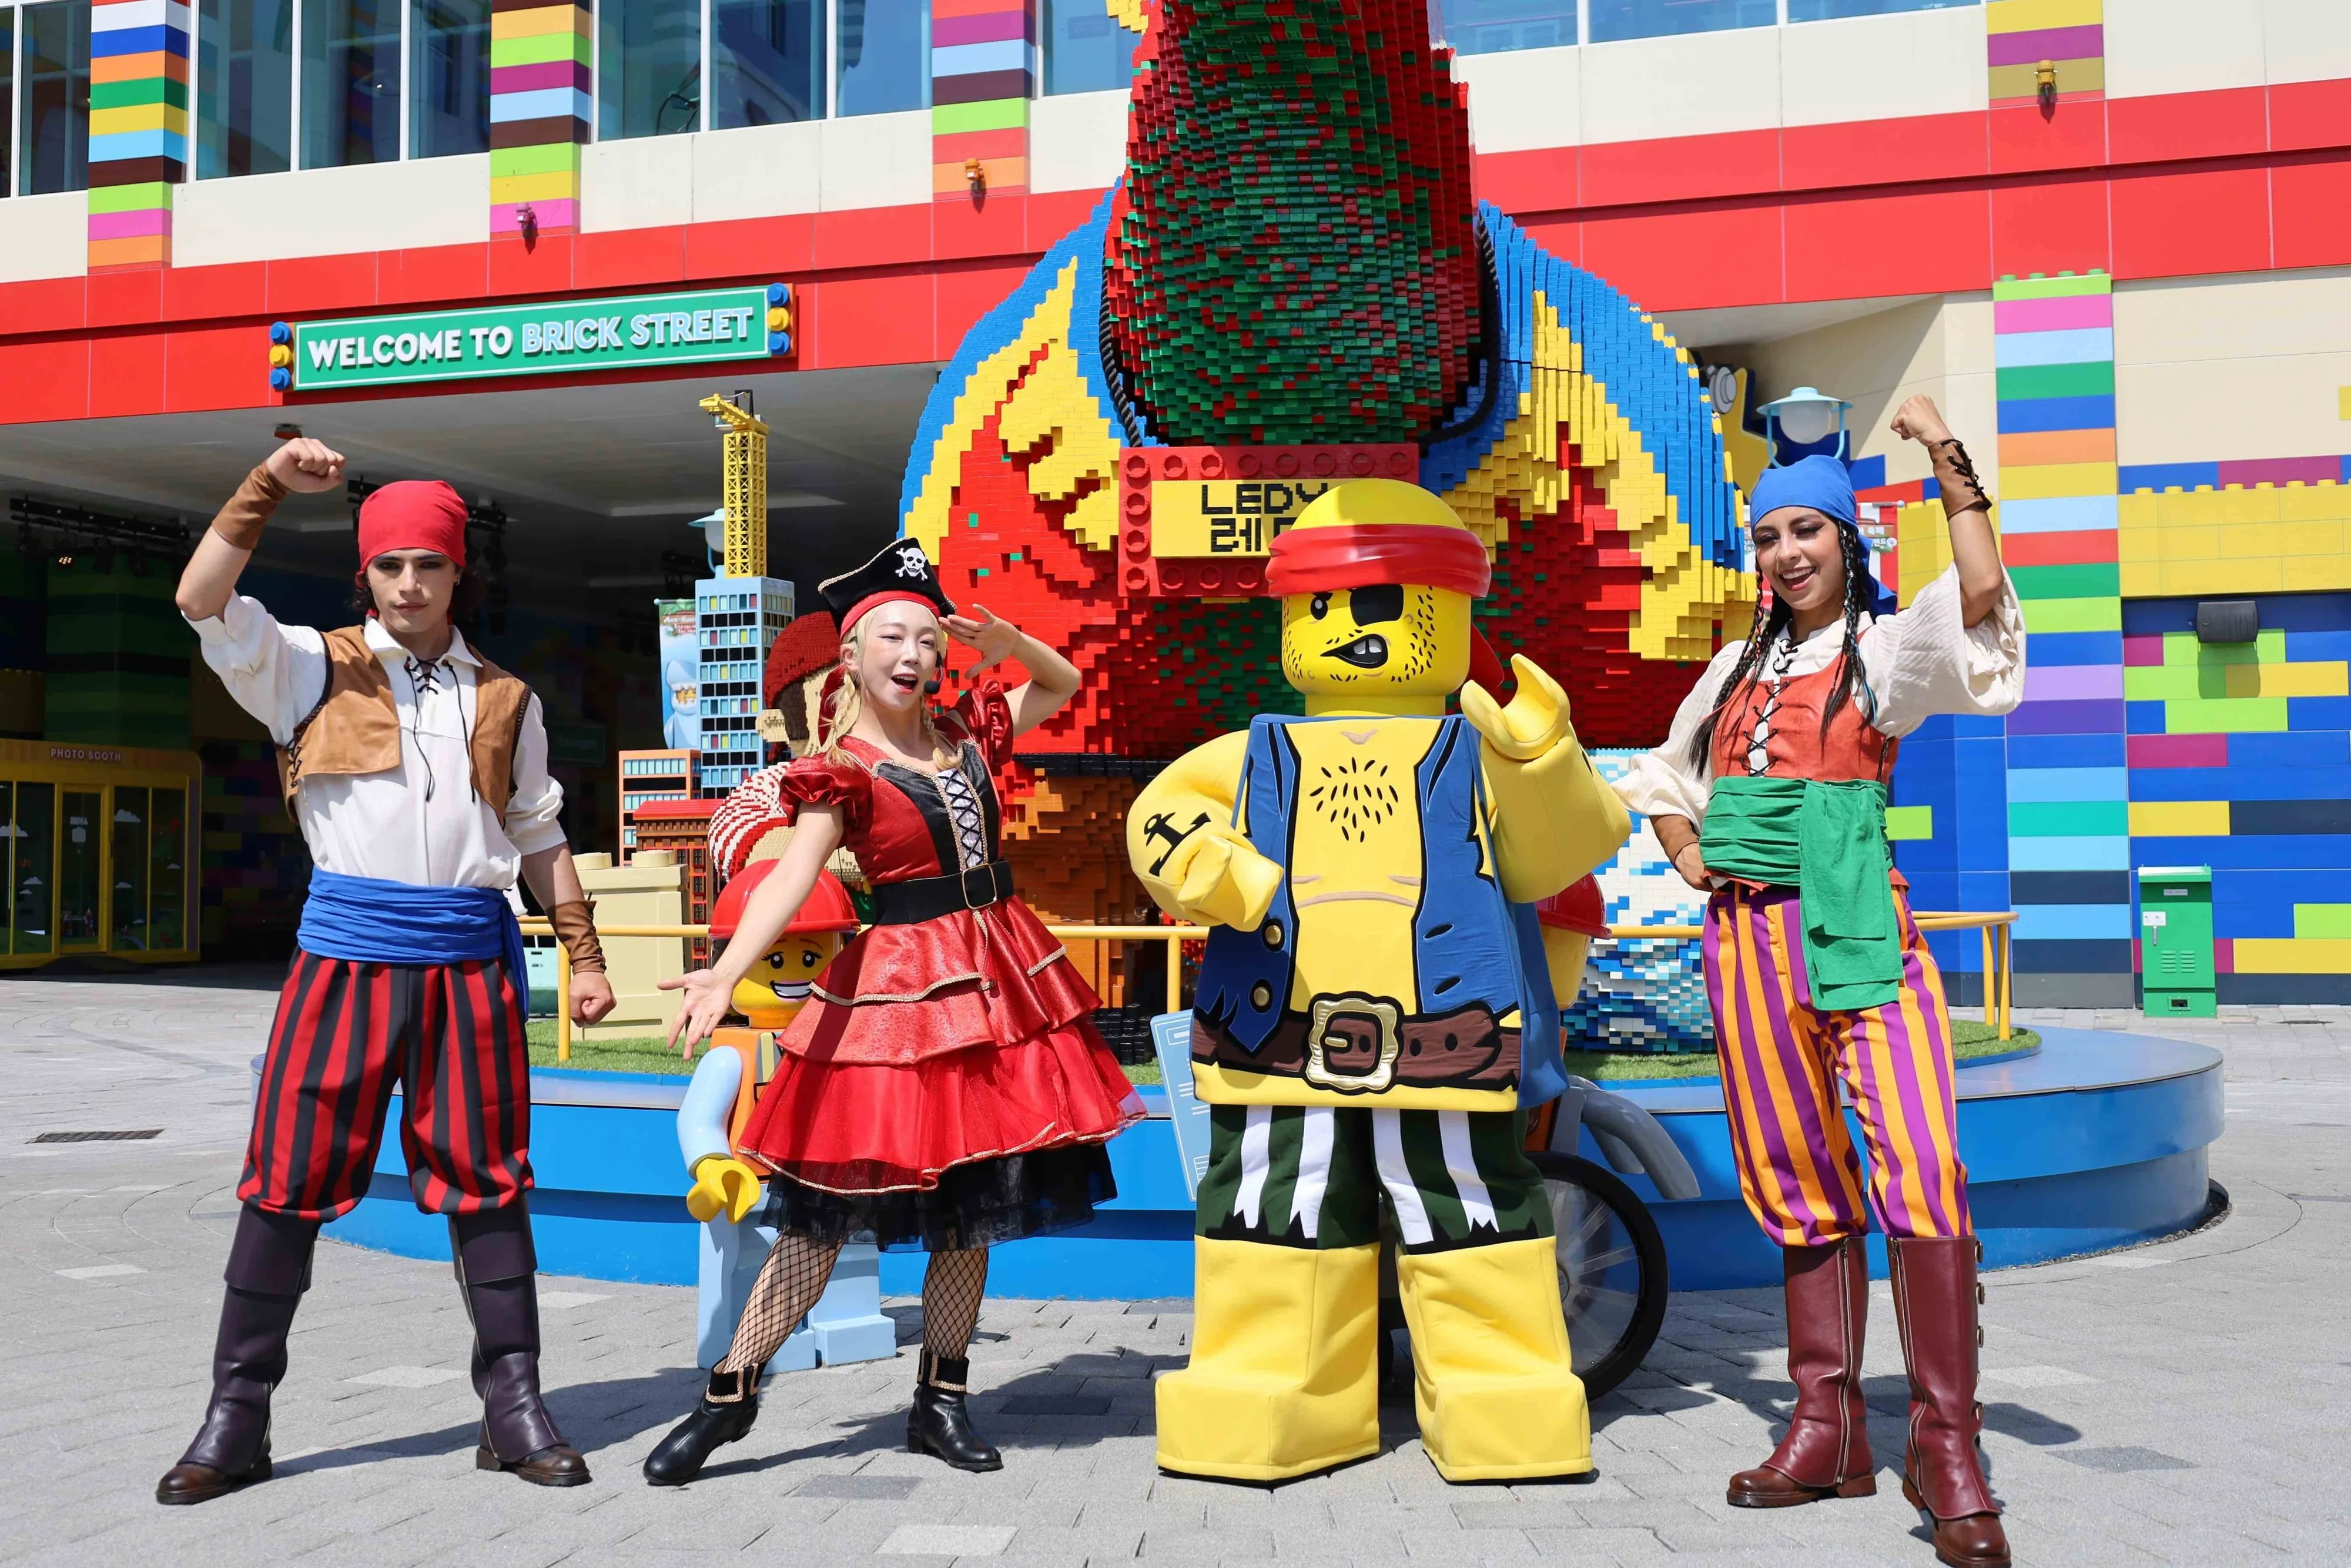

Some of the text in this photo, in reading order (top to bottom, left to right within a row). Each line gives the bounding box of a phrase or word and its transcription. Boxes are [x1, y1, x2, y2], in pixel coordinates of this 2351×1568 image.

[307, 307, 754, 369] WELCOME TO BRICK STREET
[51, 748, 121, 761] PHOTO BOOTH
